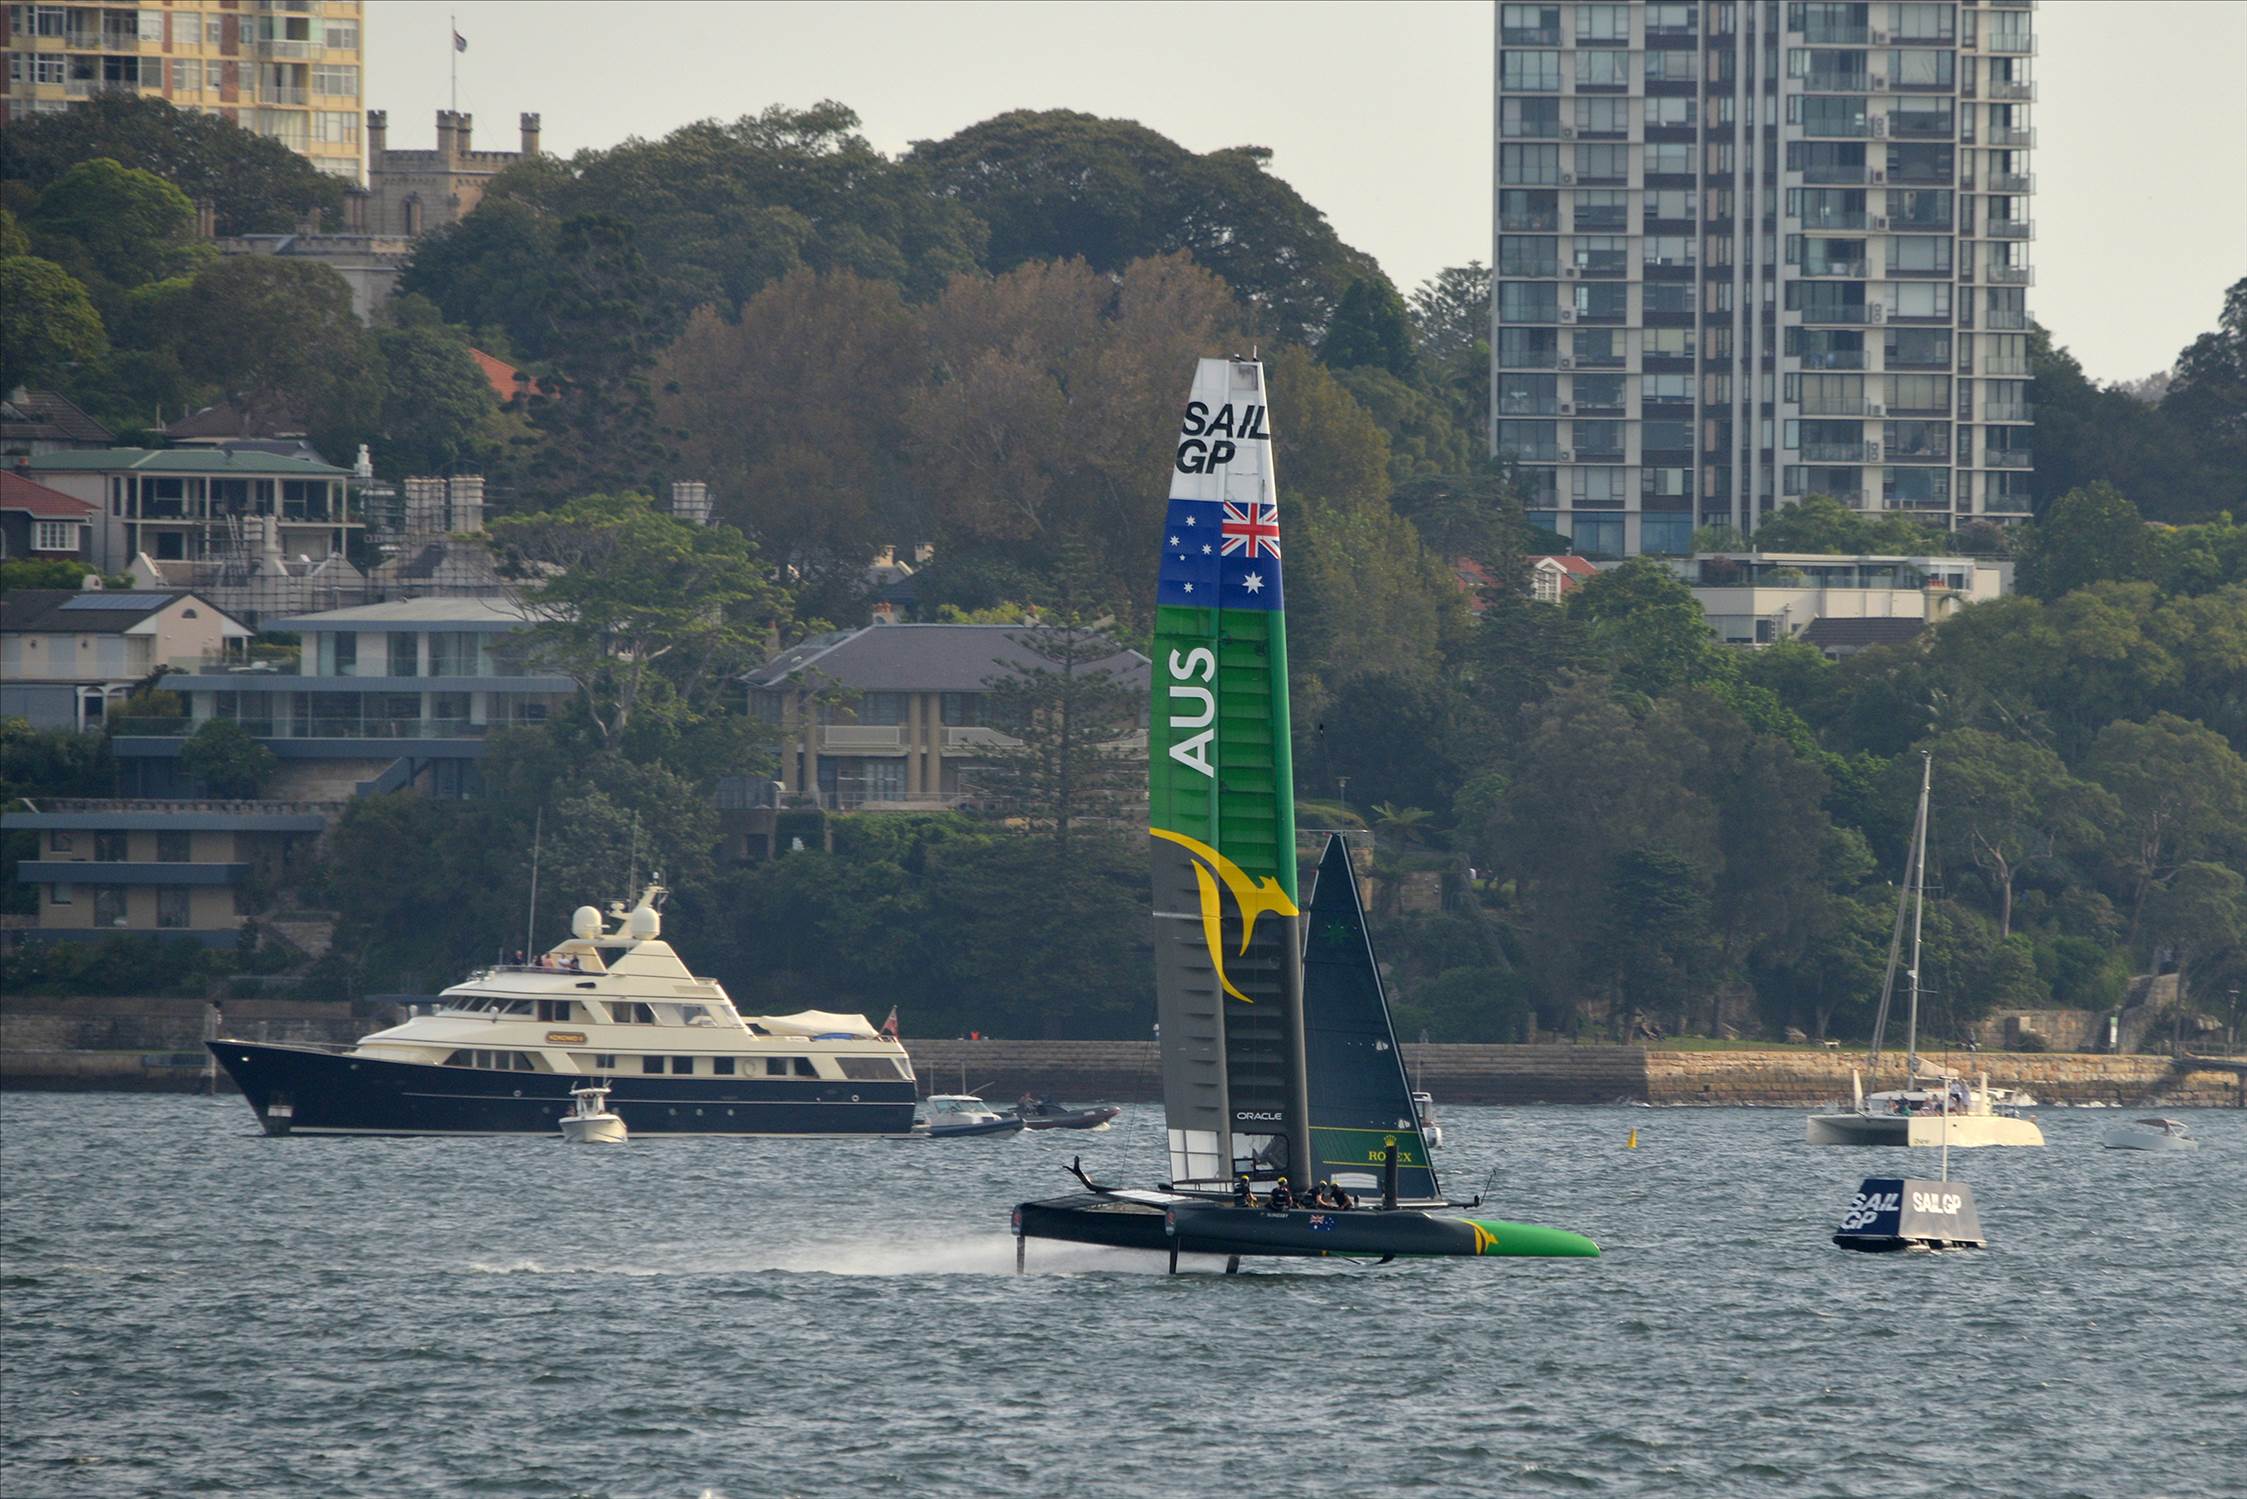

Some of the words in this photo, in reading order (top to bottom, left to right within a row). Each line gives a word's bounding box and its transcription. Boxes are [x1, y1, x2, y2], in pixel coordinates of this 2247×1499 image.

[1181, 401, 1270, 440] SAIL
[1175, 438, 1236, 474] GP
[1168, 647, 1216, 779] AUS
[1236, 1111, 1283, 1121] ORACLE
[1368, 1150, 1412, 1163] ROEX
[1850, 1192, 1900, 1211] SAIL
[1840, 1211, 1878, 1230] GP
